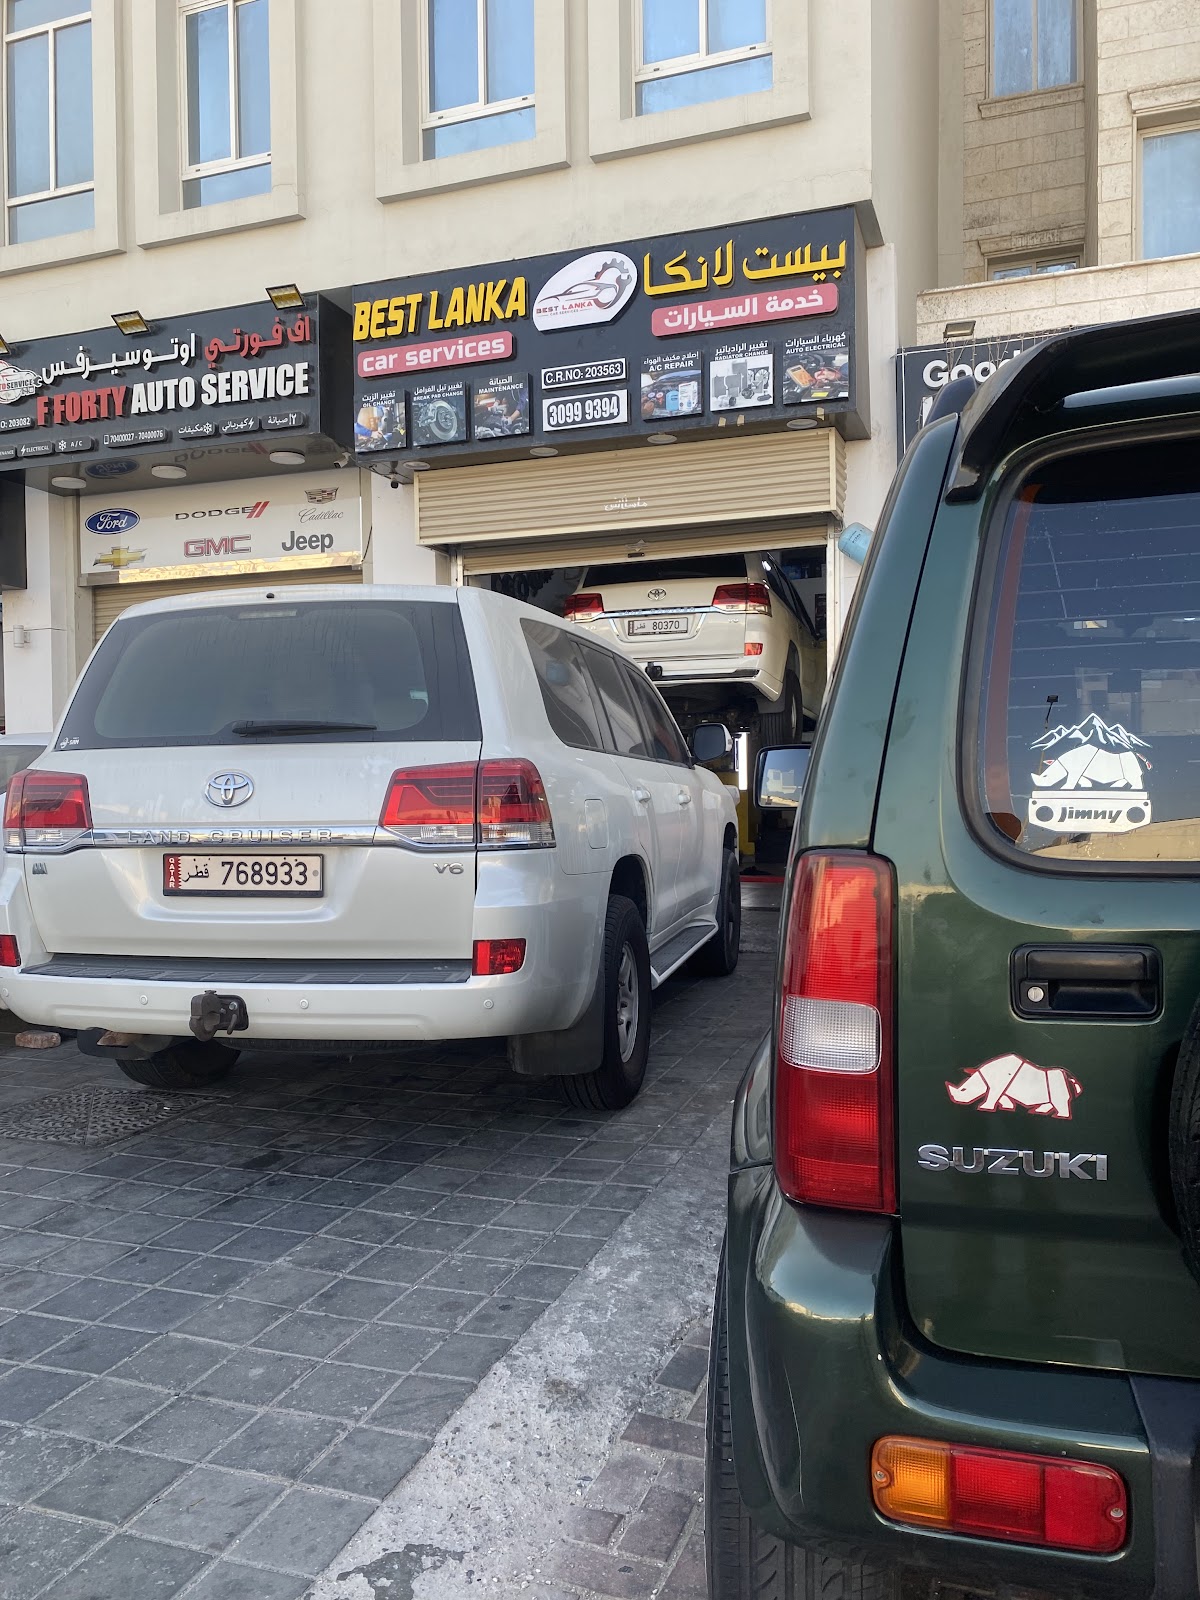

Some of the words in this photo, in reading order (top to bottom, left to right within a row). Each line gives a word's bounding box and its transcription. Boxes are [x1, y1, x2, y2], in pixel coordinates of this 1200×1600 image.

[643, 239, 733, 296] لانكا
[742, 239, 846, 282] بيست
[353, 293, 422, 341] BEST
[428, 276, 526, 330] LANKA
[536, 306, 559, 314] BEST
[562, 301, 593, 310] LANKA
[765, 289, 823, 313] خدمة
[664, 297, 758, 330] السيارات
[287, 313, 310, 342] اف
[822, 332, 846, 343] كهرباء
[204, 316, 283, 369] فورتي
[785, 335, 819, 347] السيارات
[805, 342, 845, 352] ELECTRICAL
[363, 352, 398, 372] car
[405, 338, 505, 366] services
[715, 353, 743, 361] RADIATOR
[545, 369, 584, 383] C.R.NO:
[585, 363, 621, 378] 203563
[649, 364, 662, 372] A/C
[664, 360, 694, 370] REPAIR
[922, 350, 1020, 388] Goo
[7, 379, 33, 390] SERVICE
[478, 383, 524, 394] MAINTENANCE
[489, 376, 513, 387] الصيانة
[37, 396, 49, 426] F
[53, 386, 127, 424] FORTY
[131, 376, 195, 414] AUTO
[201, 362, 308, 406] SERVICE
[549, 401, 582, 425] 3099
[585, 396, 618, 420] 9394
[26, 445, 49, 453] ELECTRICAL
[175, 504, 257, 521] DODGE
[298, 507, 344, 524] Cadillac
[183, 534, 252, 558] GMC
[281, 530, 334, 553] Jeep
[652, 620, 680, 631] 80370
[127, 830, 191, 844] LAND
[210, 829, 334, 844] CRUISER
[168, 857, 176, 888] QATAR
[182, 863, 209, 882] قطر
[221, 861, 308, 886] 768933
[433, 862, 465, 875] V6
[917, 1144, 1108, 1181] SUZUKI
